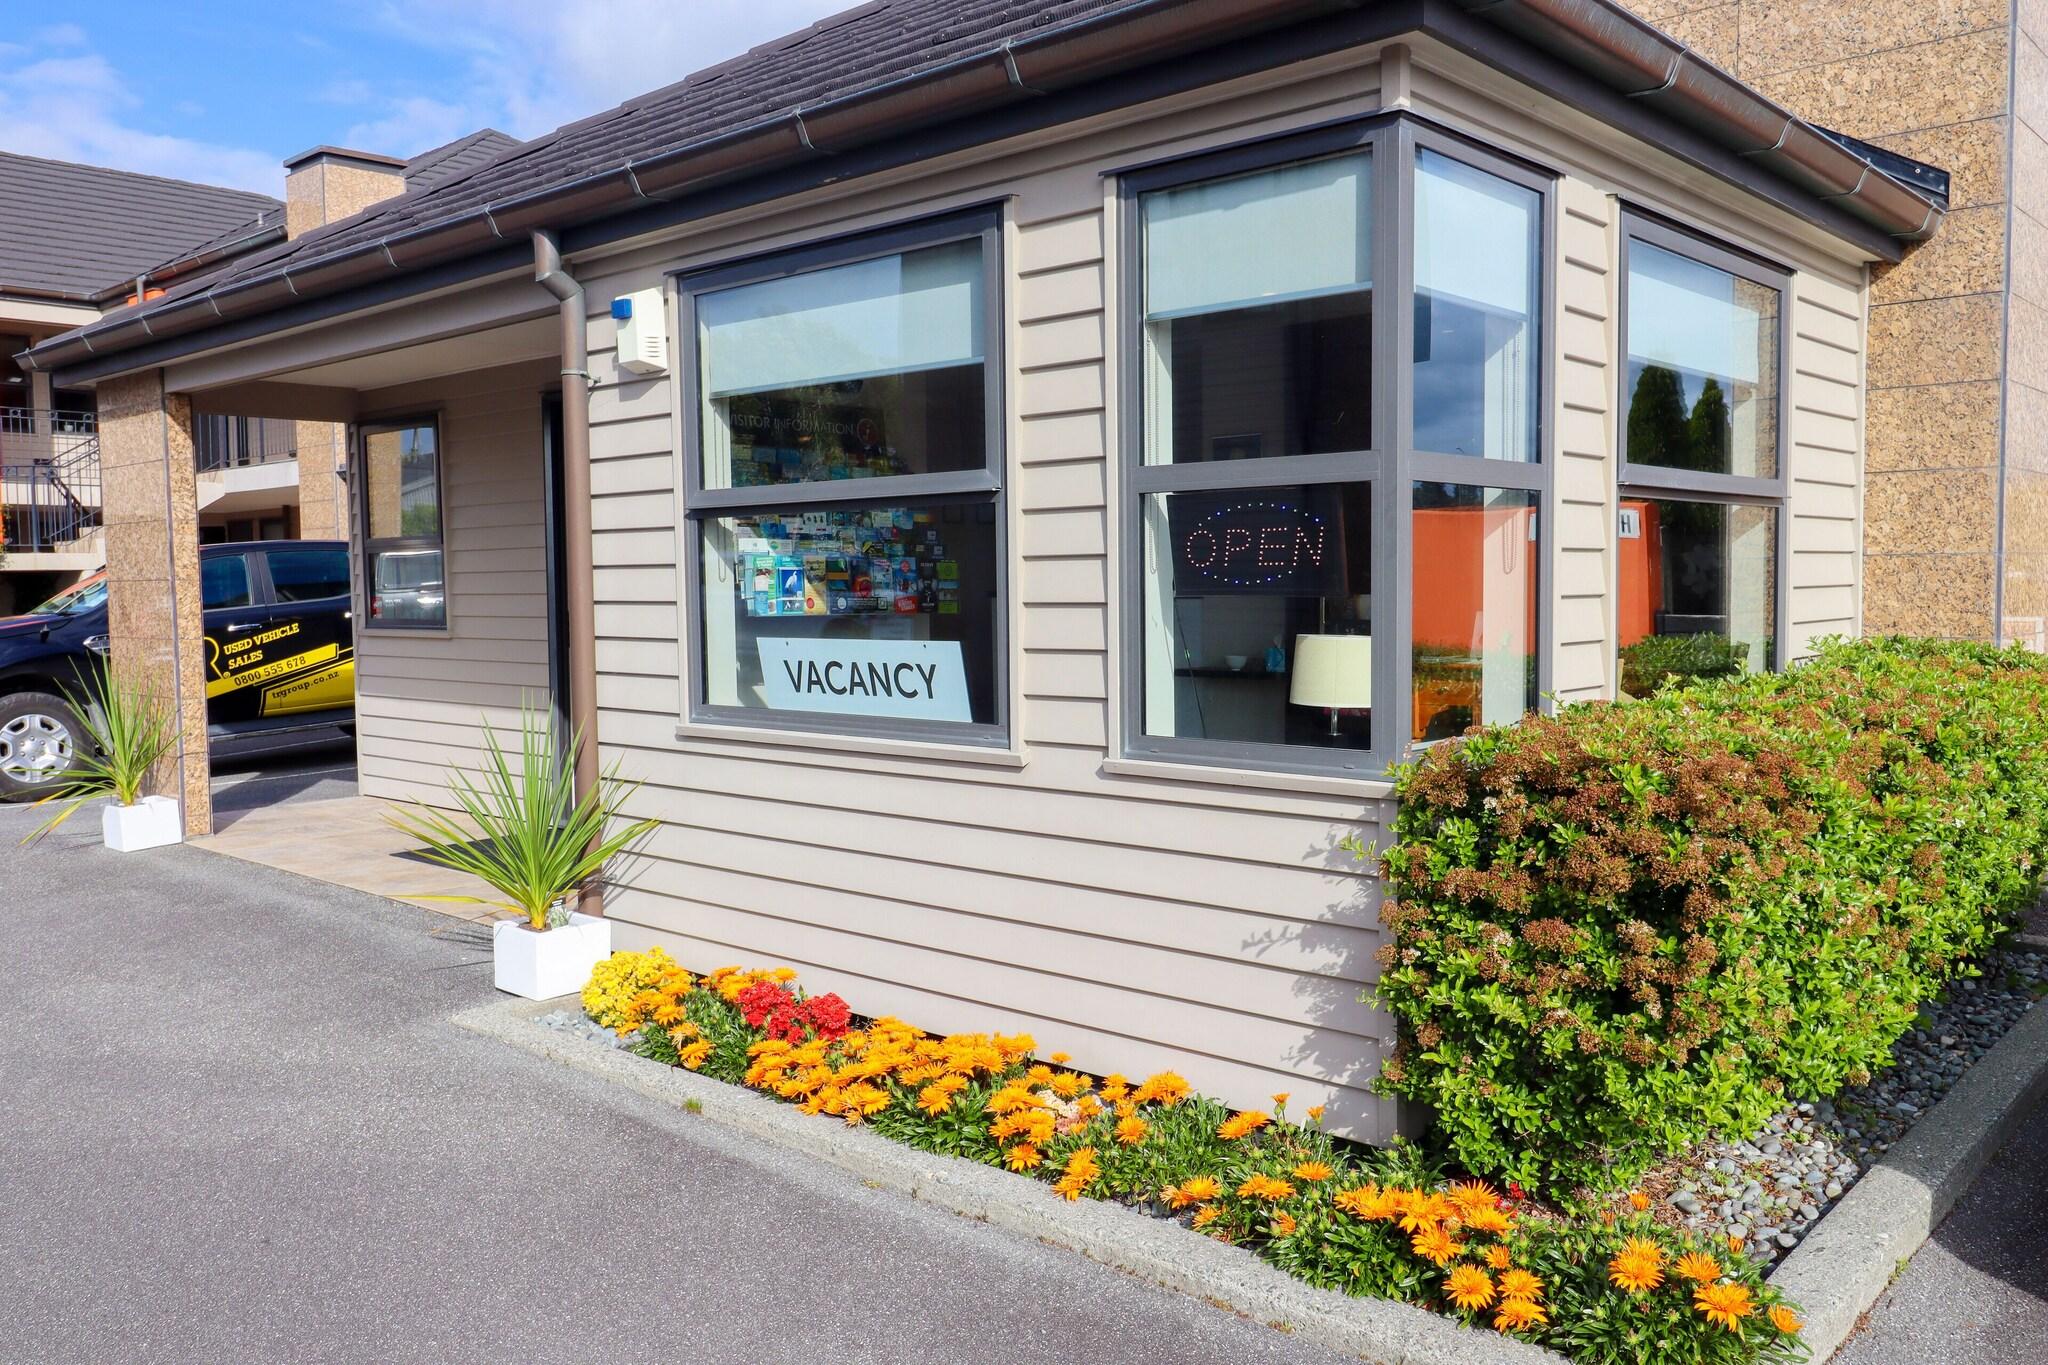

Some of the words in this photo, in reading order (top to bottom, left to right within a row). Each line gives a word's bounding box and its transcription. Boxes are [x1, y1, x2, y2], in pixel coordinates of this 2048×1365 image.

[774, 418, 854, 435] INFORMATION
[1187, 526, 1325, 567] OPEN
[223, 639, 252, 654] USED
[253, 623, 299, 644] VEHICLE
[228, 651, 263, 668] SALES
[235, 671, 261, 686] 0800
[263, 663, 284, 677] 555
[287, 656, 306, 669] 678
[272, 671, 340, 699] trgroup.co.nz
[783, 659, 936, 699] VACANCY
